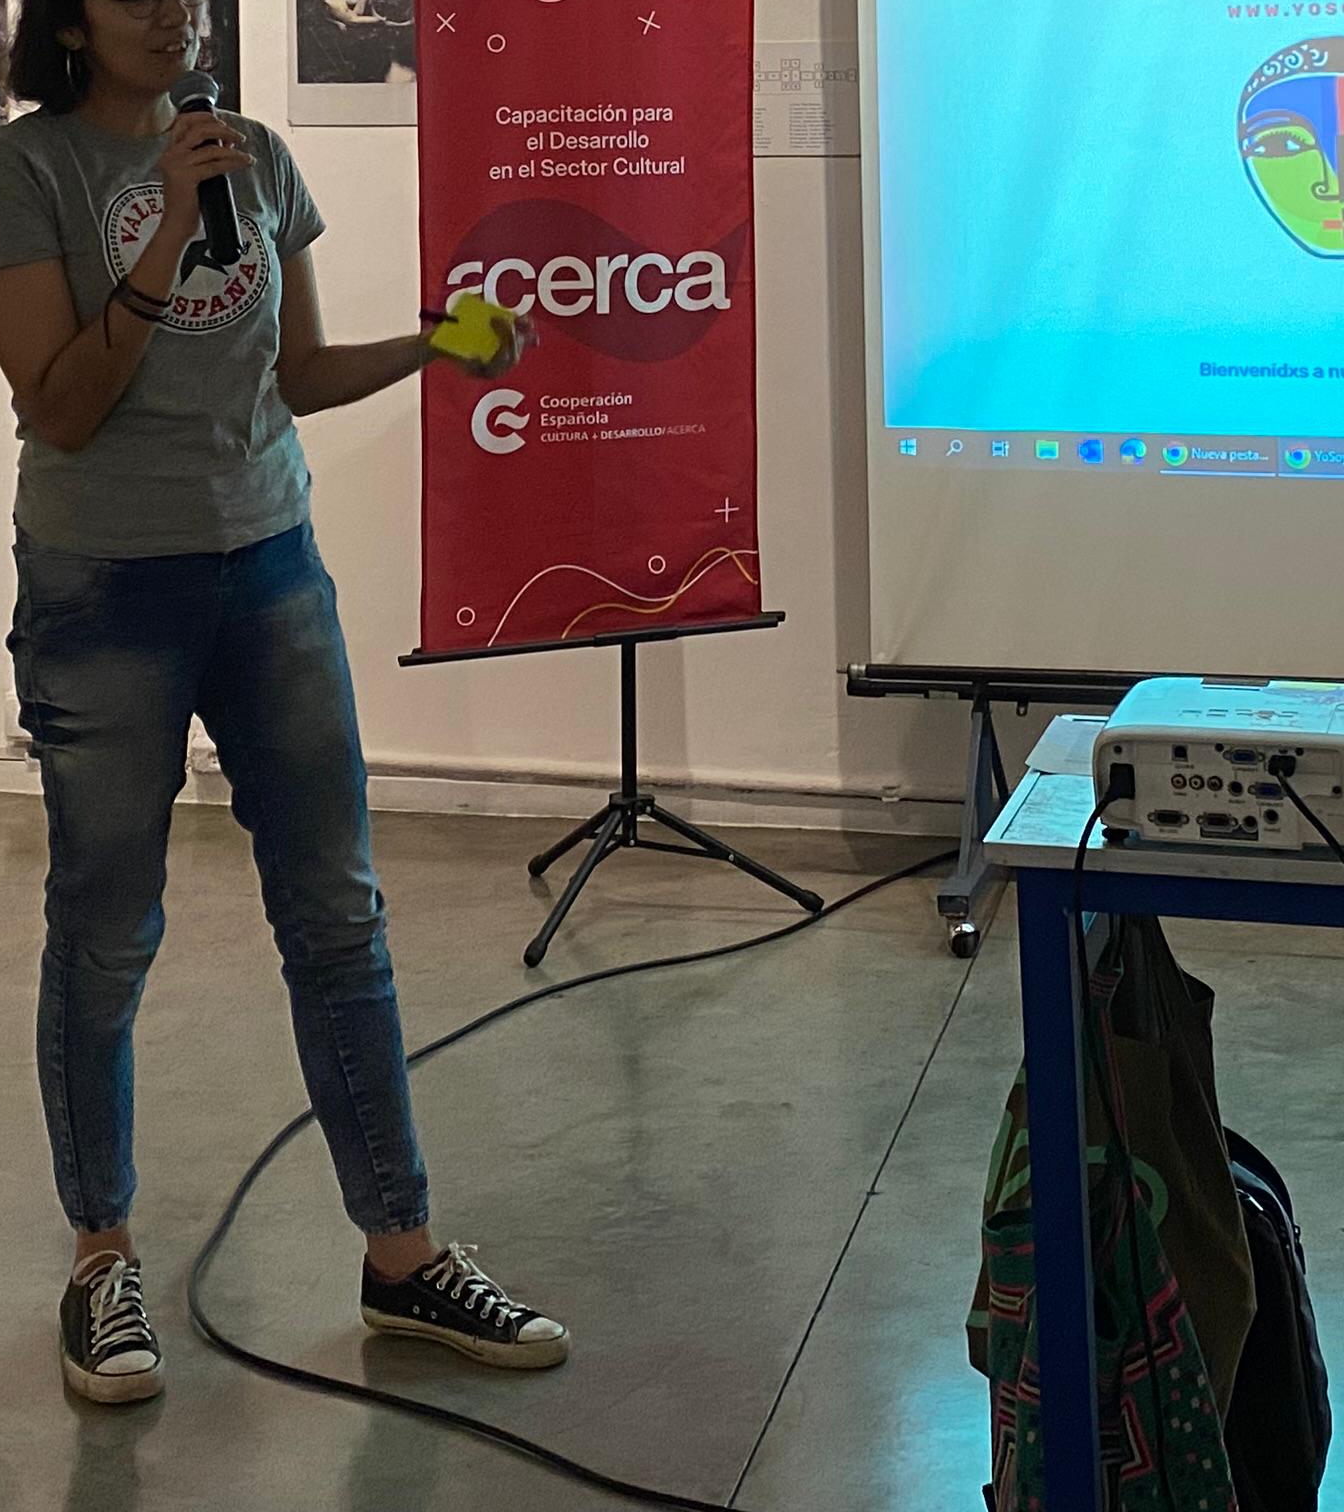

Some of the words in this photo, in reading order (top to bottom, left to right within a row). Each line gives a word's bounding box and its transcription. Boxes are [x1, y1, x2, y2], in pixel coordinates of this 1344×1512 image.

[495, 104, 627, 128] Capacitación
[632, 107, 673, 126] para
[526, 132, 544, 150] el
[549, 130, 649, 150] Desarrollo
[489, 164, 513, 180] en
[518, 160, 535, 178] el
[540, 159, 608, 177] Sector
[613, 156, 685, 176] Cultural
[172, 263, 258, 318] SPAÑA
[1199, 361, 1309, 379] Bienvenidxs
[1312, 367, 1324, 379] a
[539, 391, 633, 410] Cooperación
[540, 411, 609, 429] Española
[540, 432, 589, 443] CULTURA
[1191, 447, 1227, 460] Nueva
